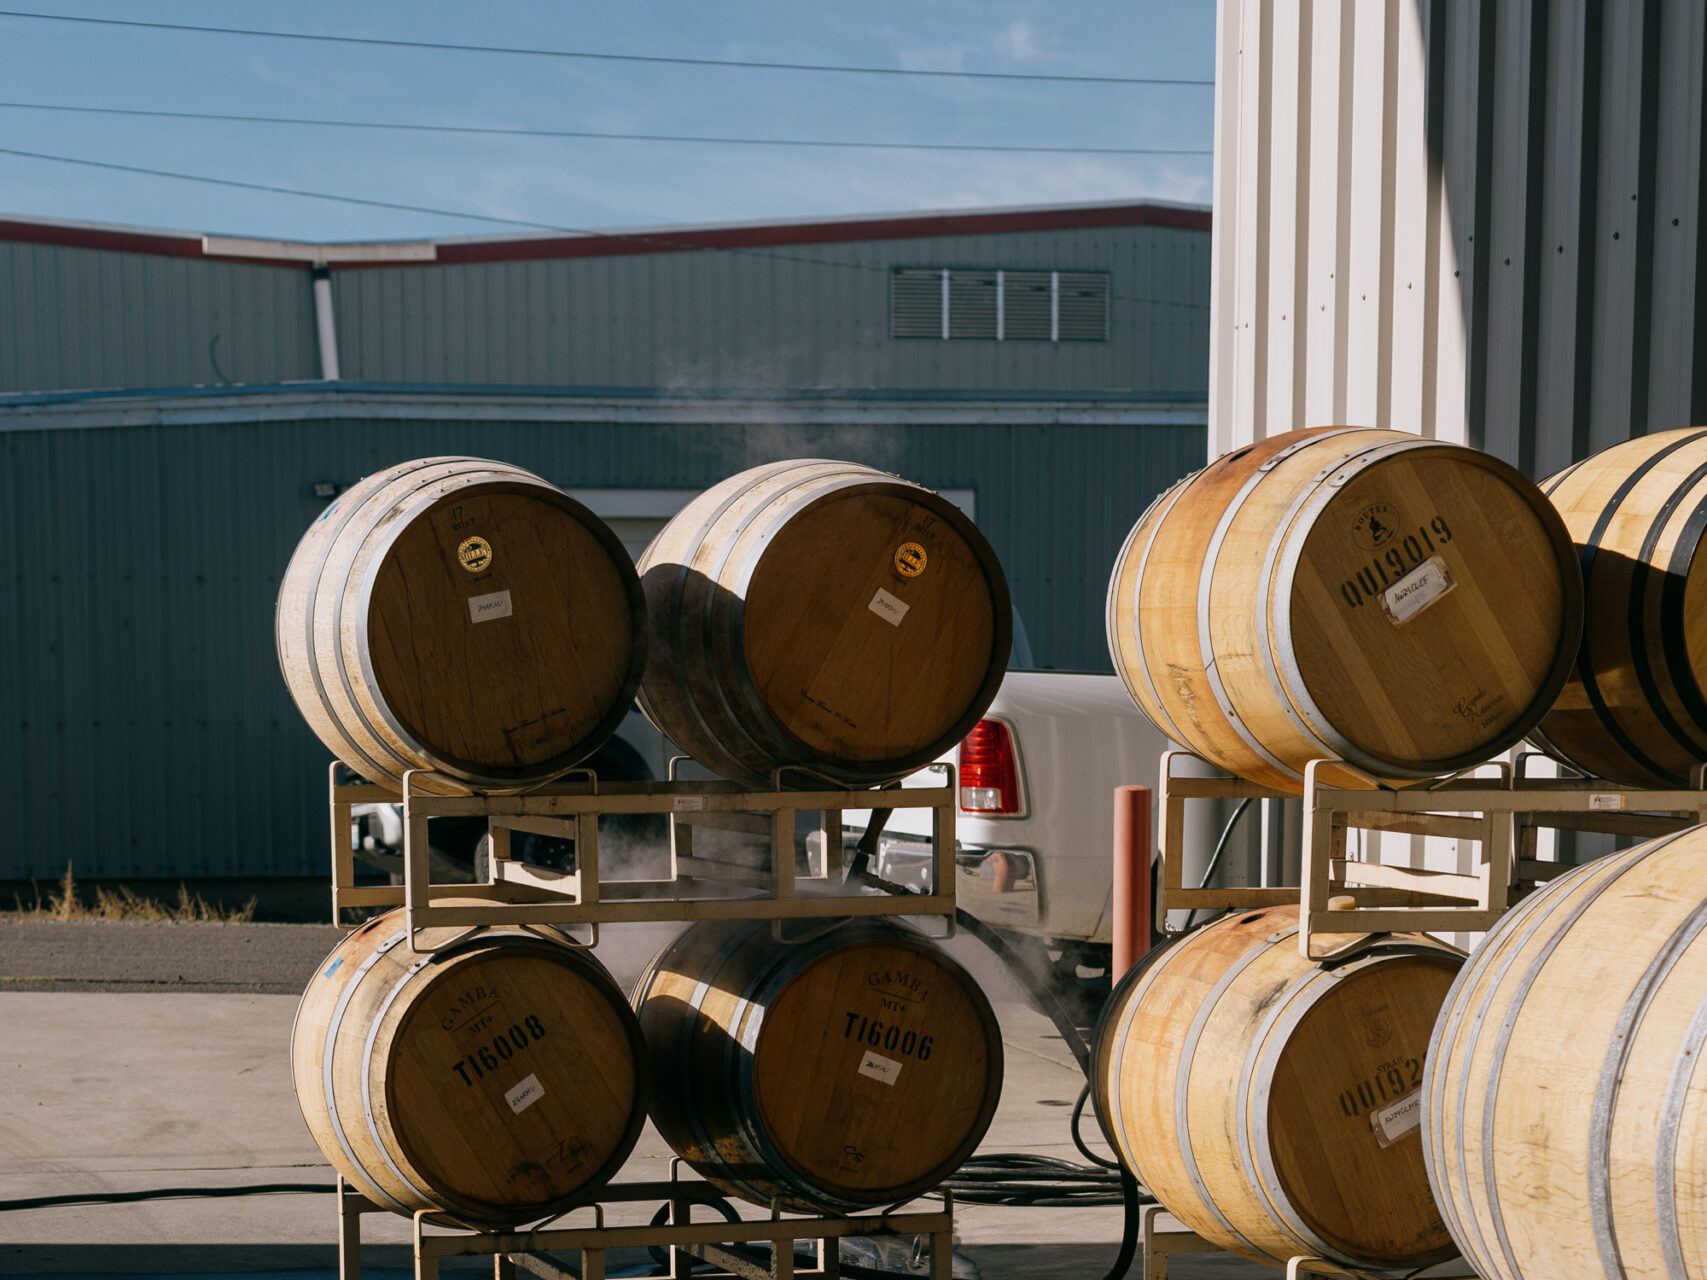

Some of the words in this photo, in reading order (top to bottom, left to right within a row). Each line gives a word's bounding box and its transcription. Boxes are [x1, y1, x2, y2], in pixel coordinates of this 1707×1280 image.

[1354, 505, 1388, 531] BOUTES
[868, 970, 929, 1002] GAMBA
[441, 987, 498, 1031] GAMBA
[1340, 1050, 1427, 1116] QU192
